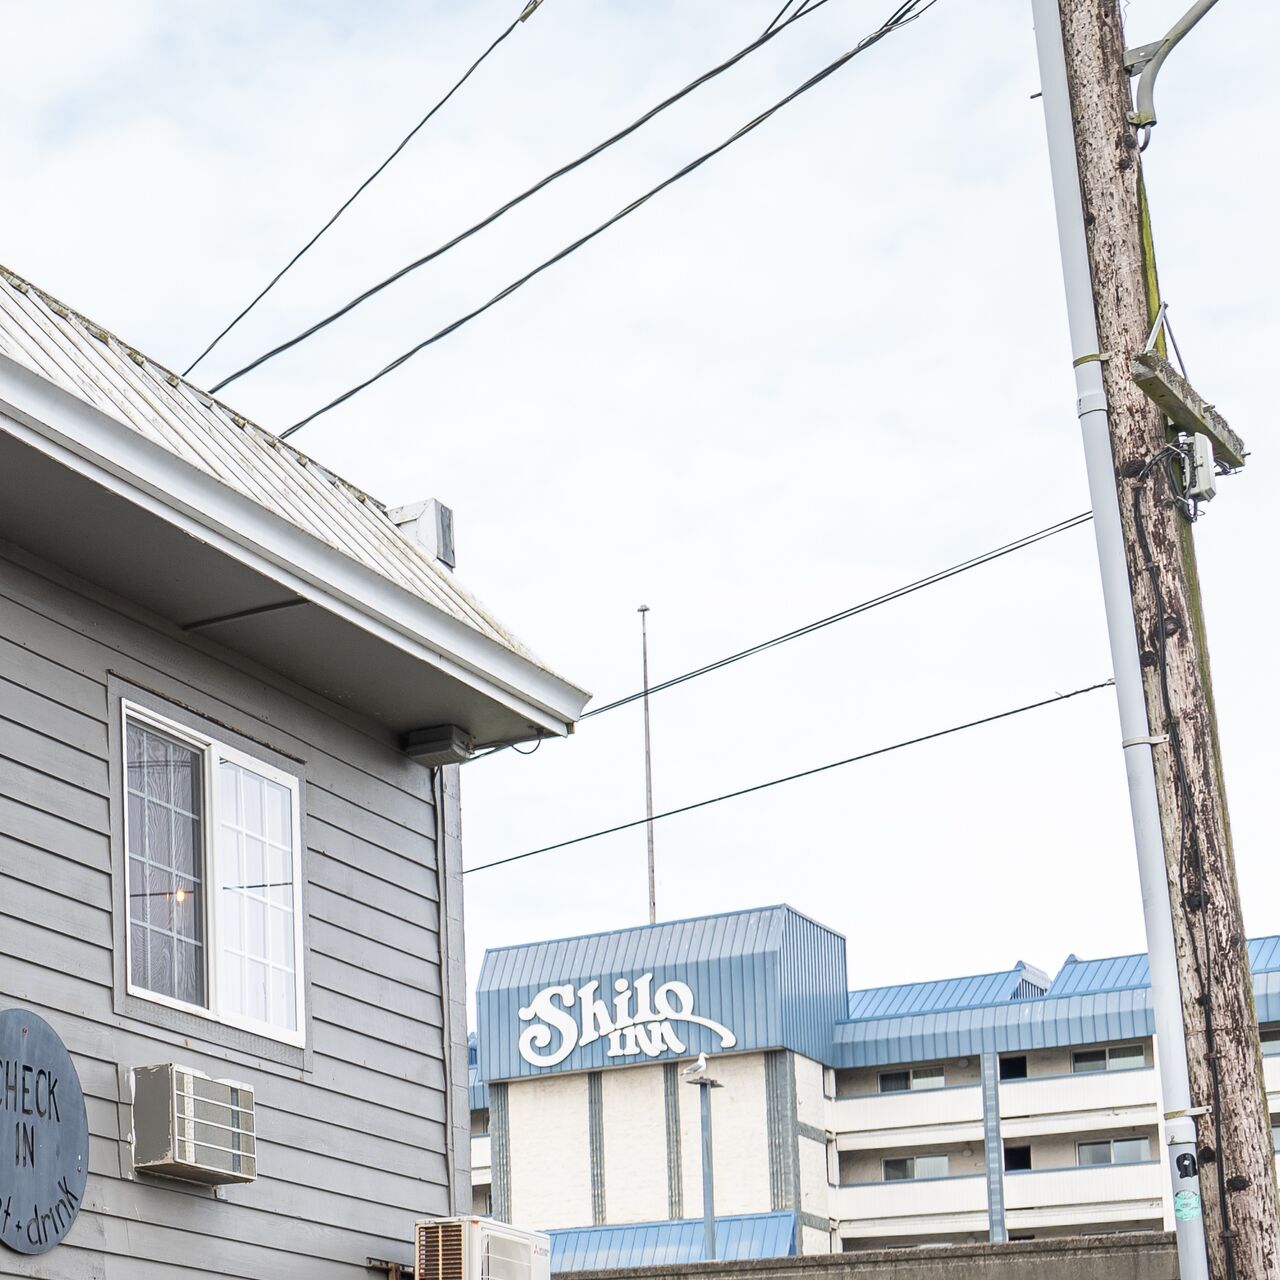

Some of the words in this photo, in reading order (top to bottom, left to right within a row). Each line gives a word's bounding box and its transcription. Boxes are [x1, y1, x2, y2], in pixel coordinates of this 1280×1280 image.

[518, 972, 737, 1067] Shilo
[15, 1121, 35, 1168] IN
[26, 1175, 79, 1247] drink
